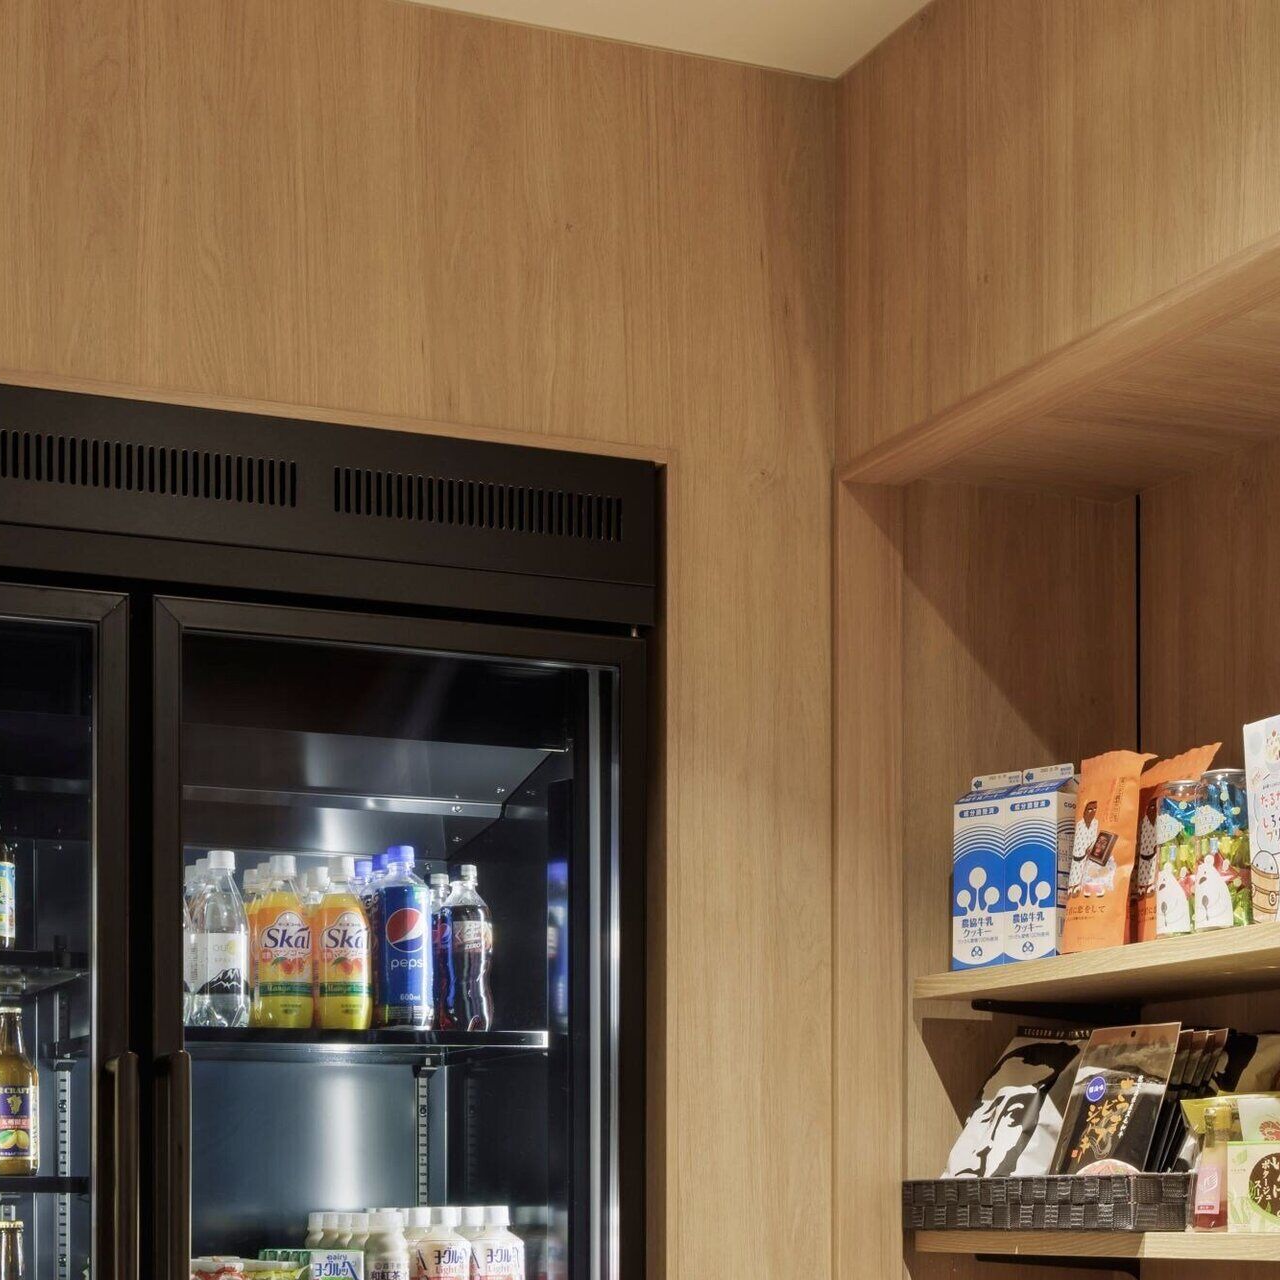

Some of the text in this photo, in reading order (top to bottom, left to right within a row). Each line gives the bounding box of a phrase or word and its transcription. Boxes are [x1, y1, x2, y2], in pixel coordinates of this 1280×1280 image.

[961, 916, 994, 928] 農協牛乳
[1012, 912, 1045, 924] 農協牛乳
[1254, 1180, 1264, 1204] スープ
